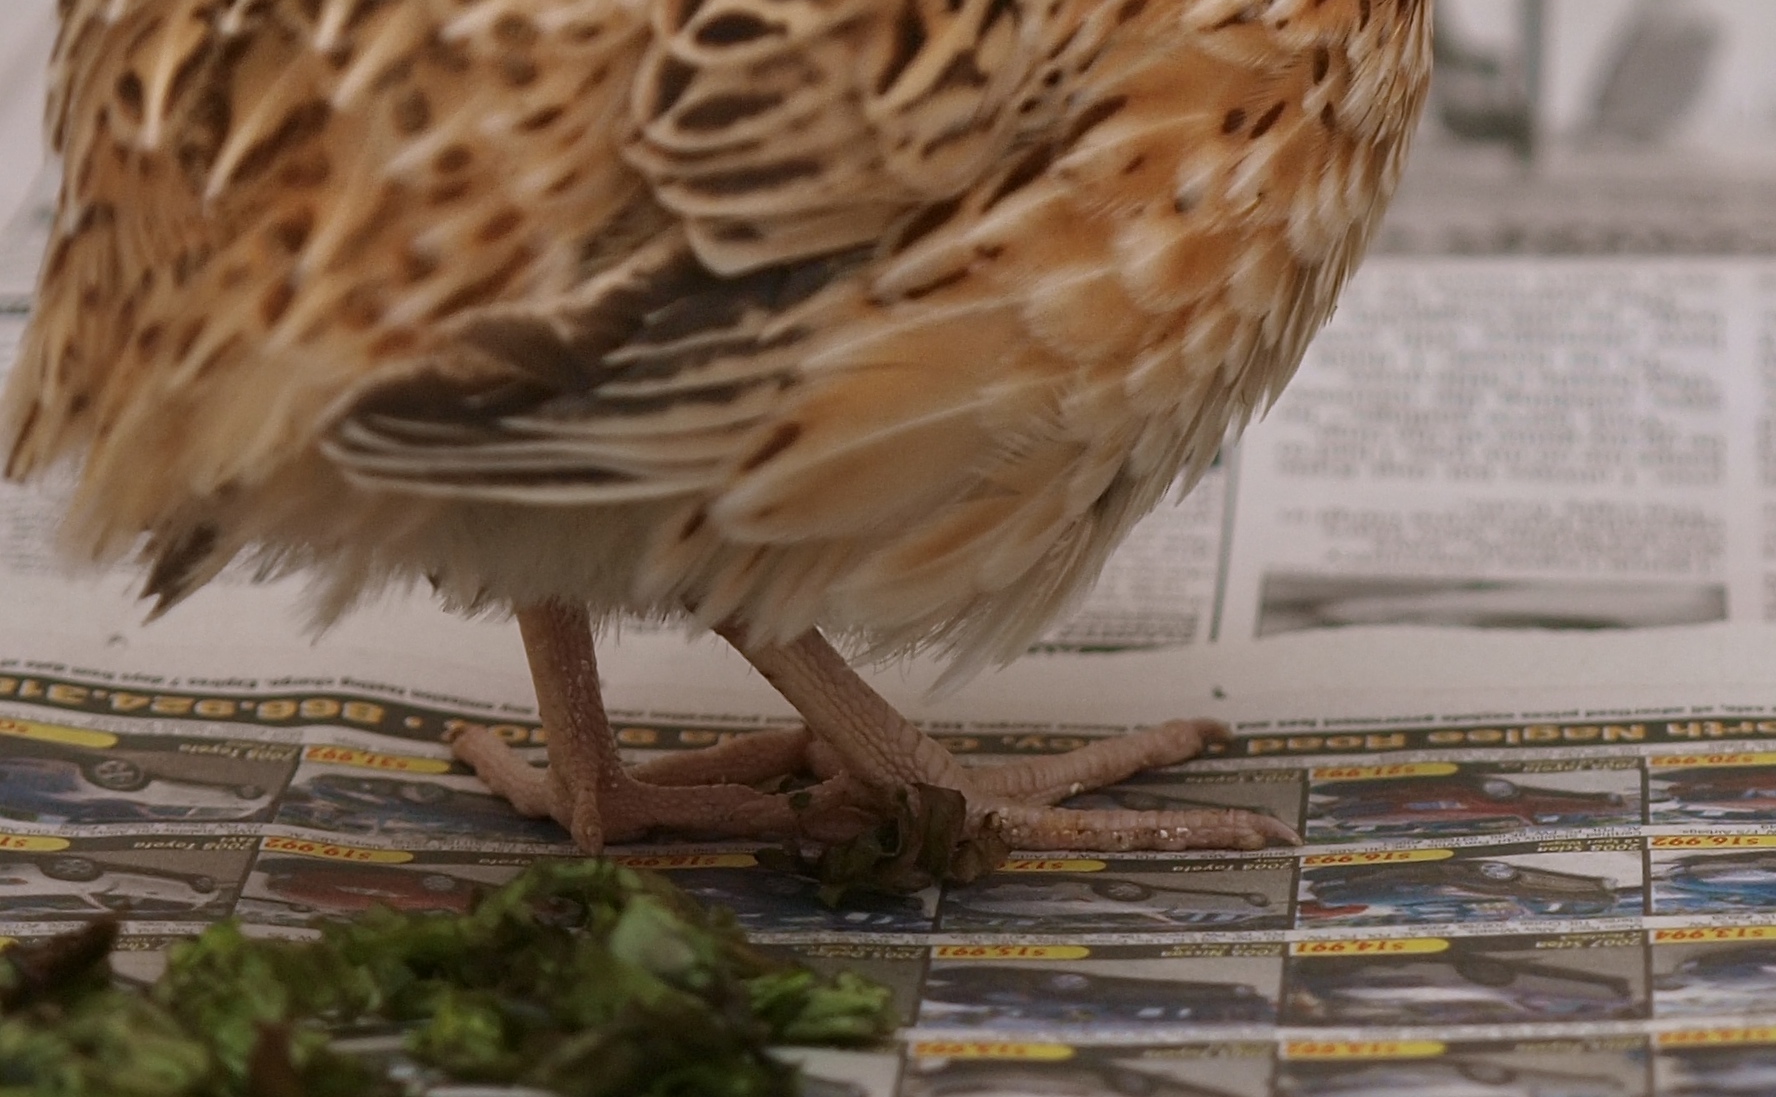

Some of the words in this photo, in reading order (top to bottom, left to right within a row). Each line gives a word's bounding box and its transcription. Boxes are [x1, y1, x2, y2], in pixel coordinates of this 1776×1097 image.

[1666, 720, 1776, 739] orth
[1246, 732, 1406, 755] Road
[133, 839, 196, 850] Toyota
[1651, 835, 1759, 847] $16,992
[264, 837, 372, 861] $19,992
[1536, 845, 1583, 853] Scion
[1590, 842, 1641, 852] 2008
[478, 858, 532, 866] oyota
[1173, 863, 1235, 873] Toyota
[1655, 927, 1764, 941] $13,994
[1297, 939, 1407, 953] $14,991
[1535, 940, 1583, 949] Scion
[1590, 937, 1642, 948] 2007
[1160, 950, 1224, 958] Nissan
